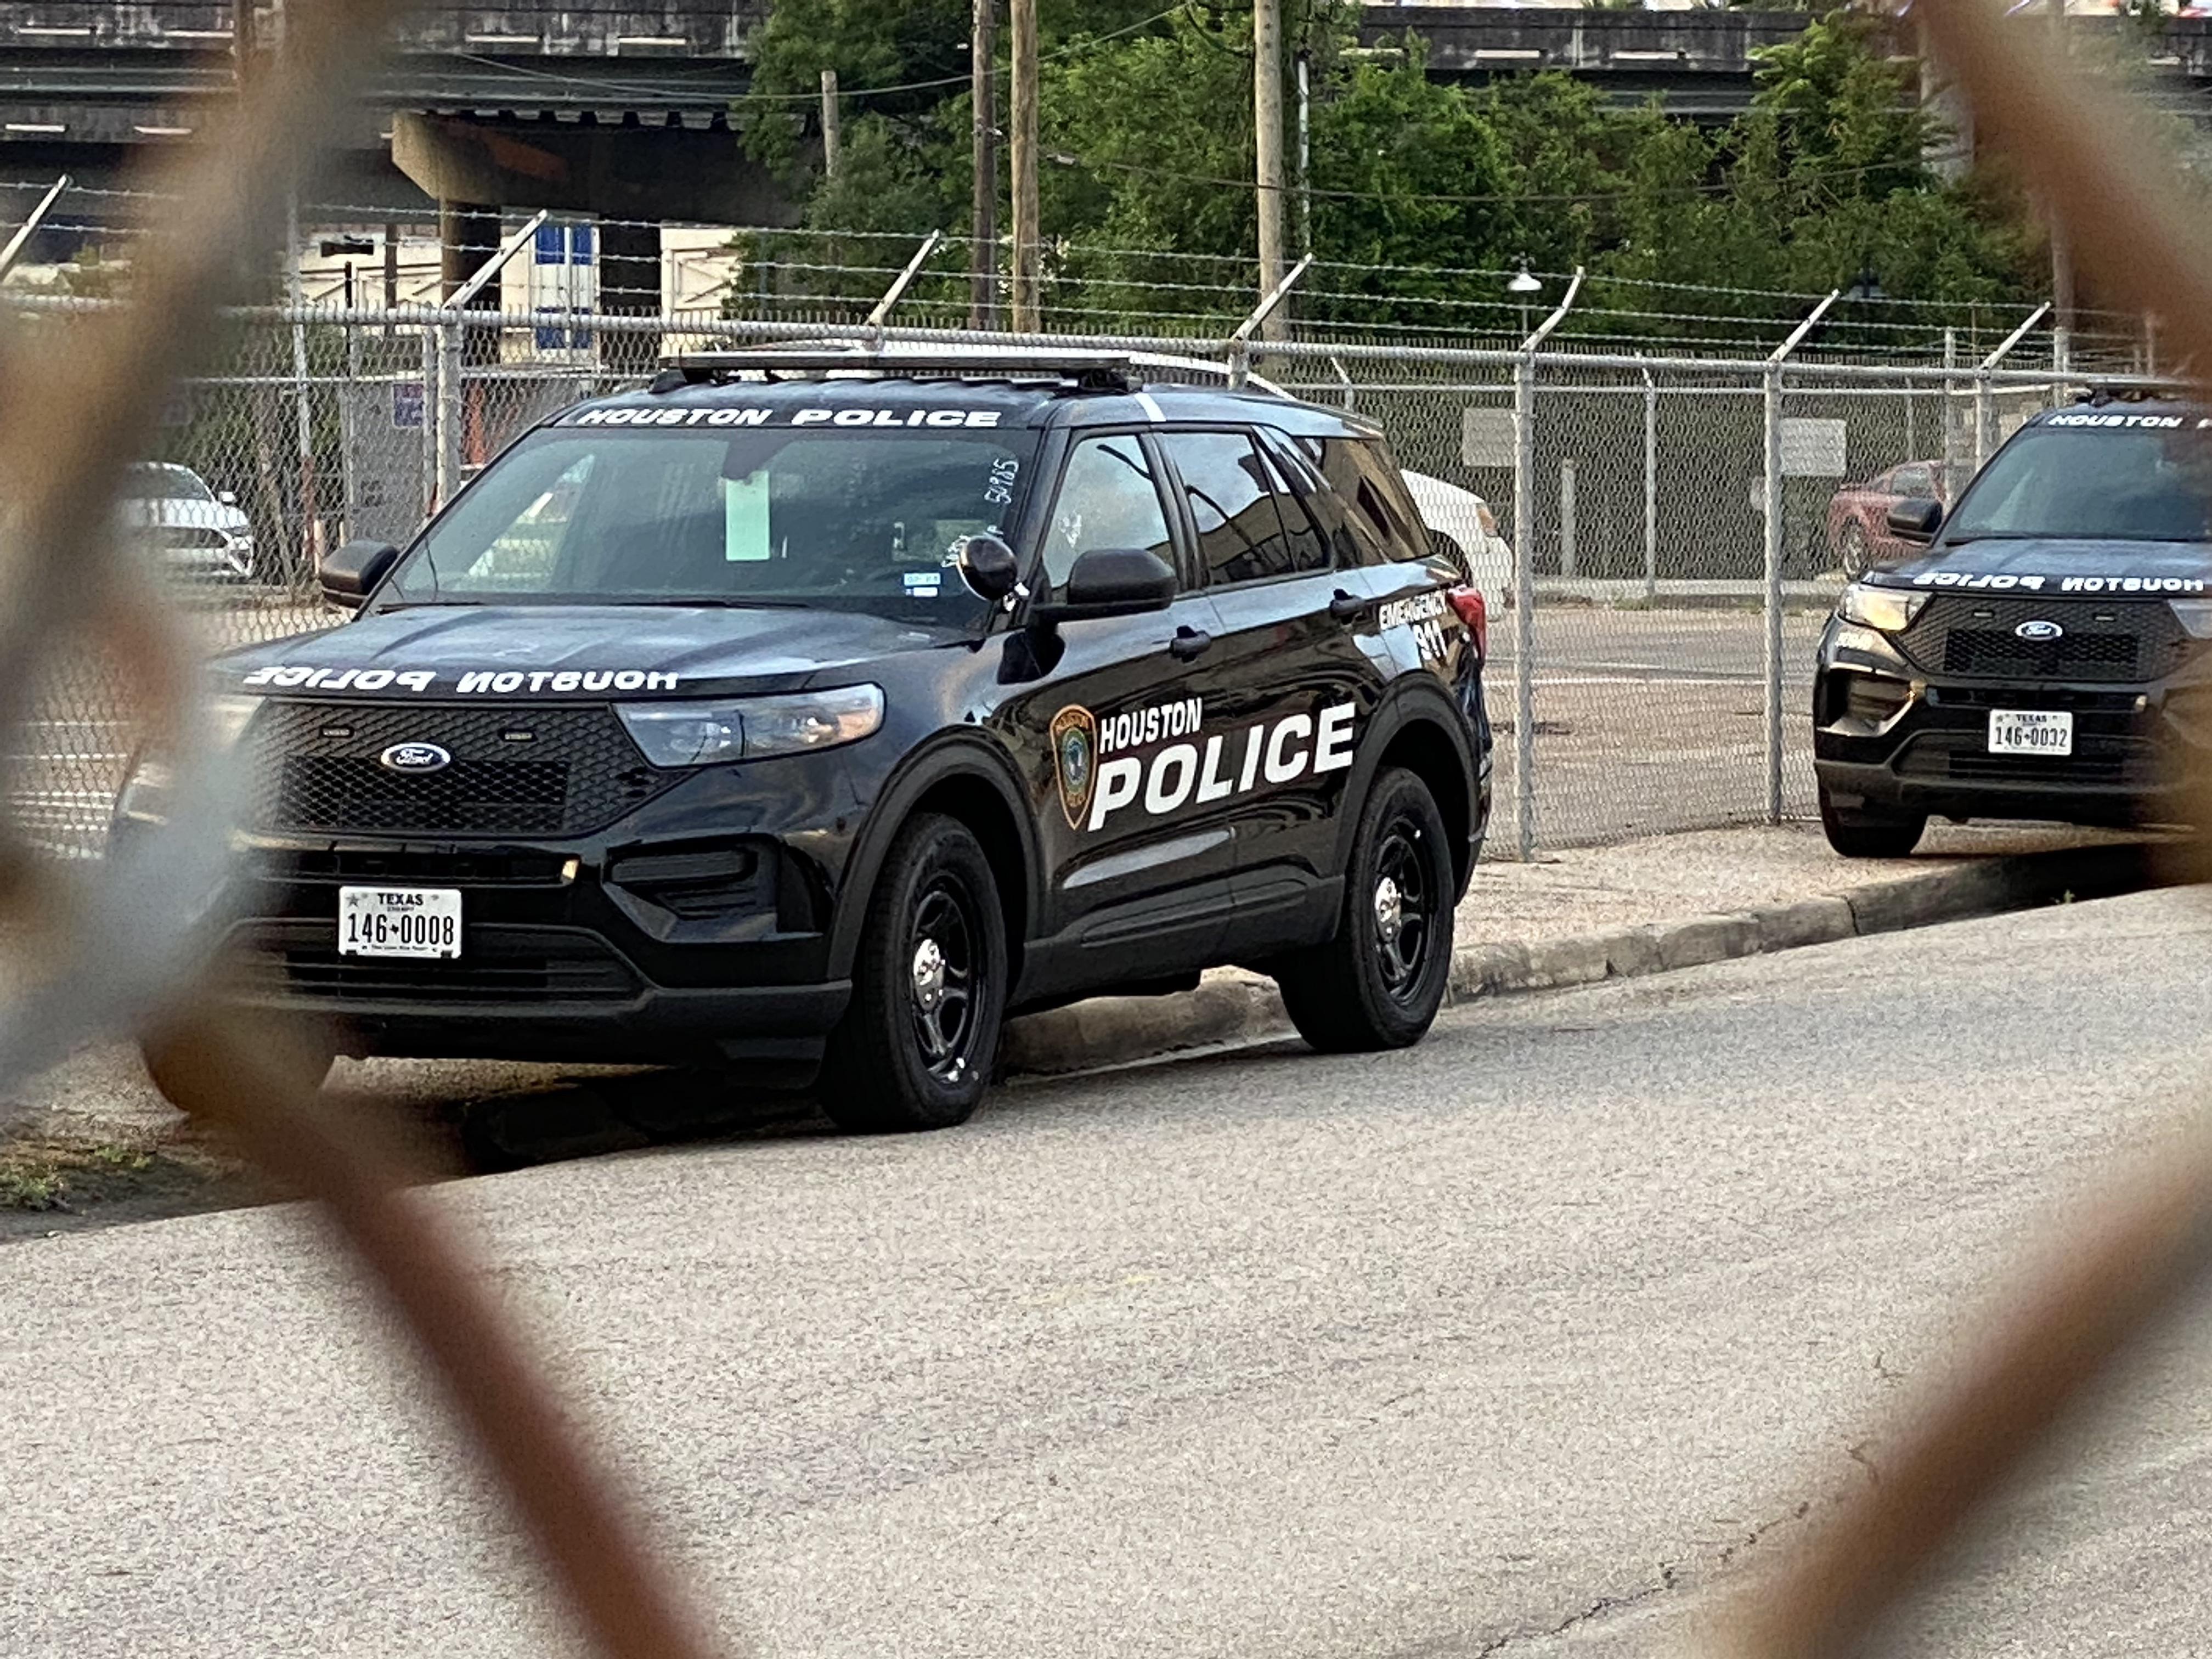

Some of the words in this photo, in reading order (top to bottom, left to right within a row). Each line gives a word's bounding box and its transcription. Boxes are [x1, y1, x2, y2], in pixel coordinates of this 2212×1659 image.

[578, 408, 772, 425] HOUSTON
[791, 409, 1001, 426] POLICE
[2048, 415, 2183, 427] HOUSTON
[1099, 697, 1202, 754] HOUSTON
[1087, 702, 1356, 832] POLICE
[377, 893, 424, 906] TEXAS
